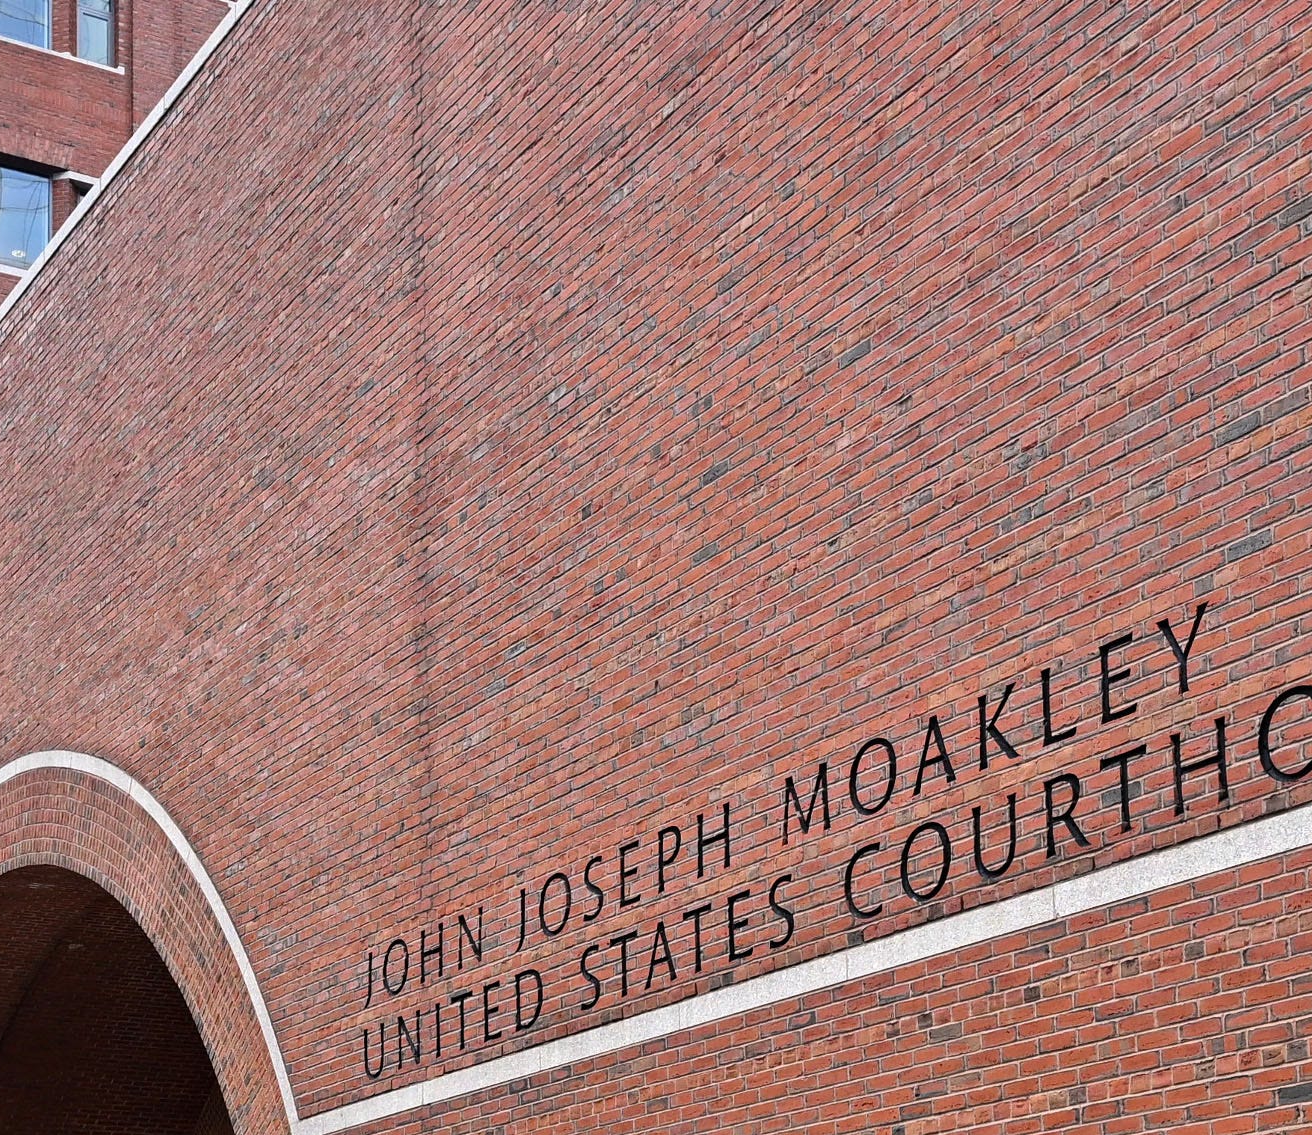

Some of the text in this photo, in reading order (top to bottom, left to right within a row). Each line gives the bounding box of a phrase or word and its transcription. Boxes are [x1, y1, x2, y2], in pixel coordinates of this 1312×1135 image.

[364, 601, 1209, 1009] JOHN JOSEPH MOAKLEY
[363, 968, 543, 1079] UNITED
[580, 873, 795, 1012] STATES
